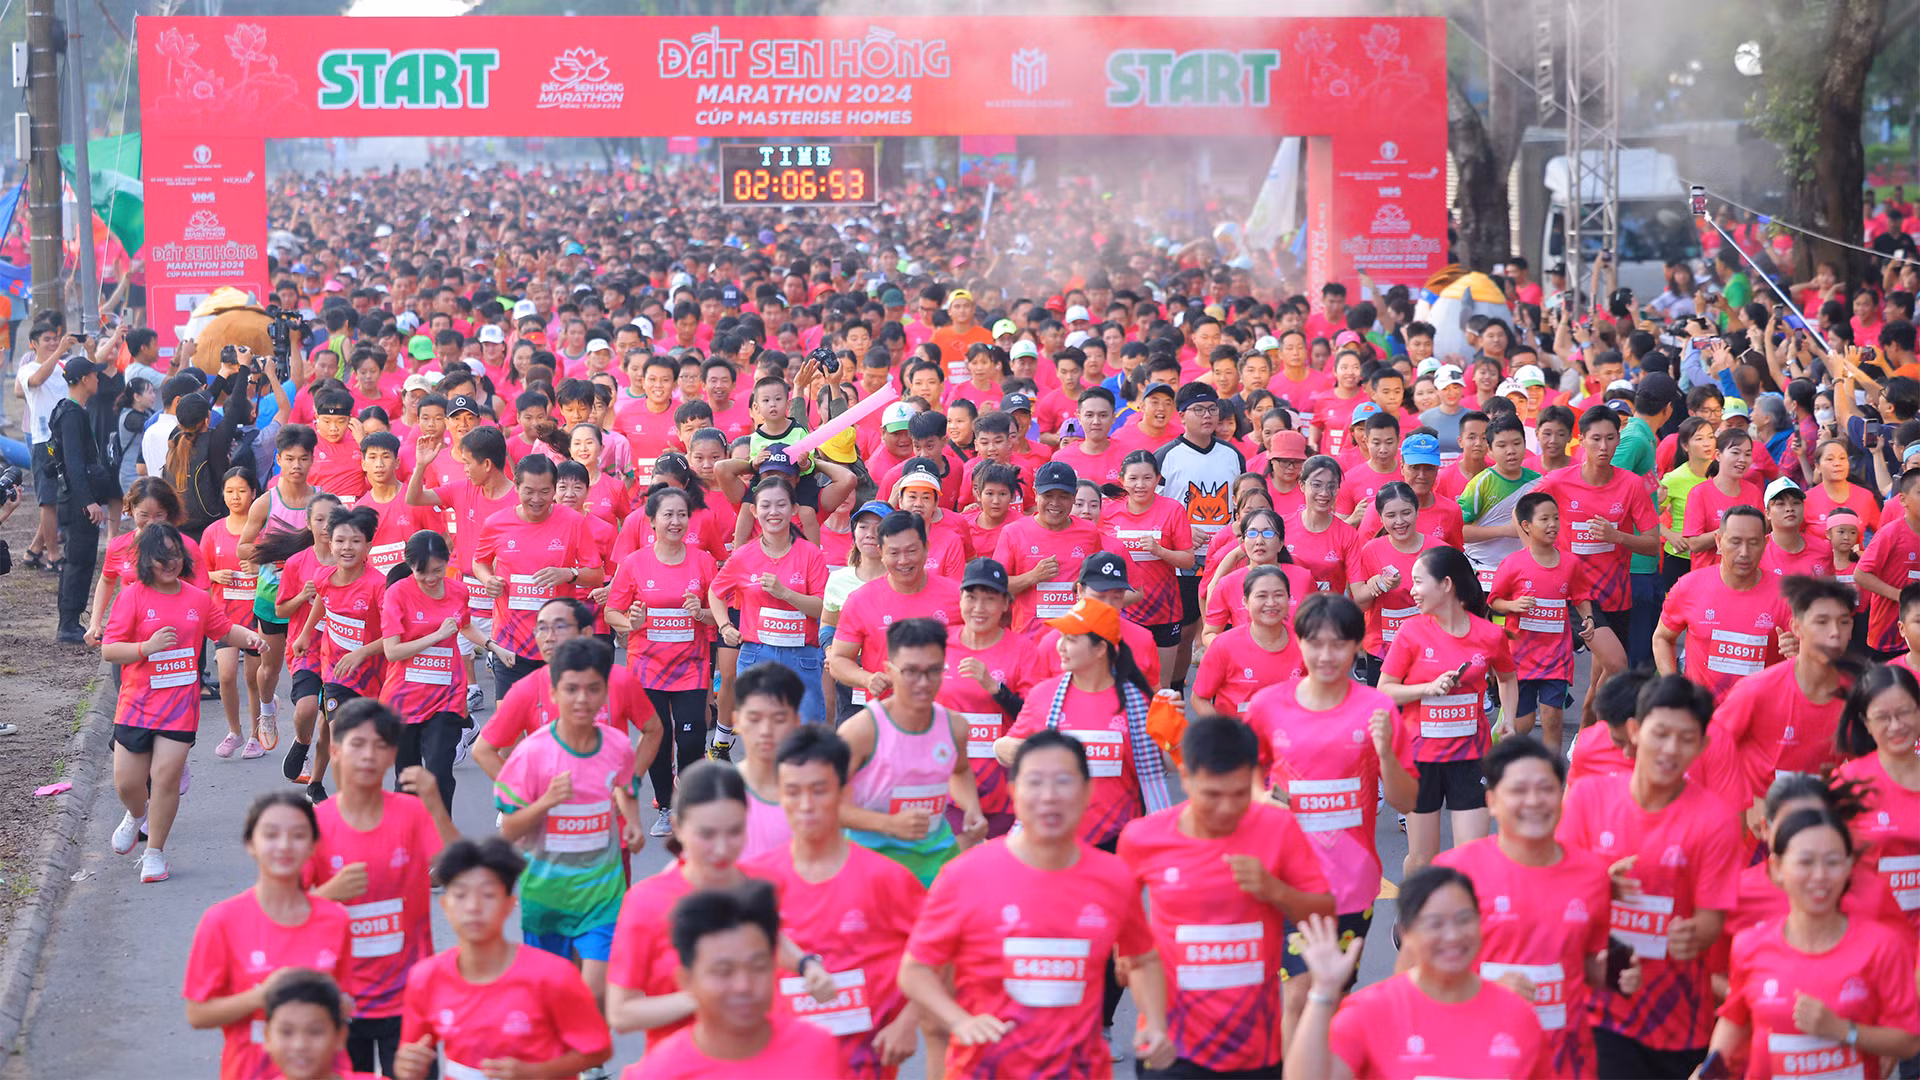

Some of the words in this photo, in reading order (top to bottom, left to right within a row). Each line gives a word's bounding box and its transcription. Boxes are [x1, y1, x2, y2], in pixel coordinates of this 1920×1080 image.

[658, 25, 743, 79] ĐẤT
[749, 39, 824, 79] SEN
[830, 25, 951, 79] HỒNG
[318, 48, 499, 109] START
[1106, 49, 1281, 108] START
[539, 92, 624, 103] MARATHON
[696, 84, 842, 104] MARATHON
[846, 83, 912, 103] 2024
[695, 108, 734, 126] CÚP
[737, 111, 842, 126] MASTERISE
[846, 110, 912, 125] HOMES
[733, 169, 865, 201] 02:06:53
[152, 242, 183, 262] ĐẤT
[185, 245, 212, 261] SEN
[214, 240, 258, 260] HỒNG
[166, 261, 219, 271] MARATHON
[221, 260, 244, 270] 2024
[182, 270, 219, 278] MASTERISE
[221, 269, 244, 277] HOMES
[768, 453, 787, 463] ACB
[372, 553, 399, 564] 50967
[516, 585, 545, 597] 51159
[1043, 591, 1074, 602] 50754
[1528, 607, 1557, 618] 52951
[652, 618, 686, 629] 52408
[763, 618, 797, 632] 52046
[1718, 643, 1755, 658] 53691
[155, 660, 186, 673] 54168
[413, 656, 446, 669] 52865
[1429, 705, 1467, 719] 51893
[1085, 745, 1110, 758] 814
[1299, 795, 1345, 810] 53014
[557, 816, 600, 832] 50915
[351, 917, 388, 935] 0018
[1186, 944, 1247, 963] 53446
